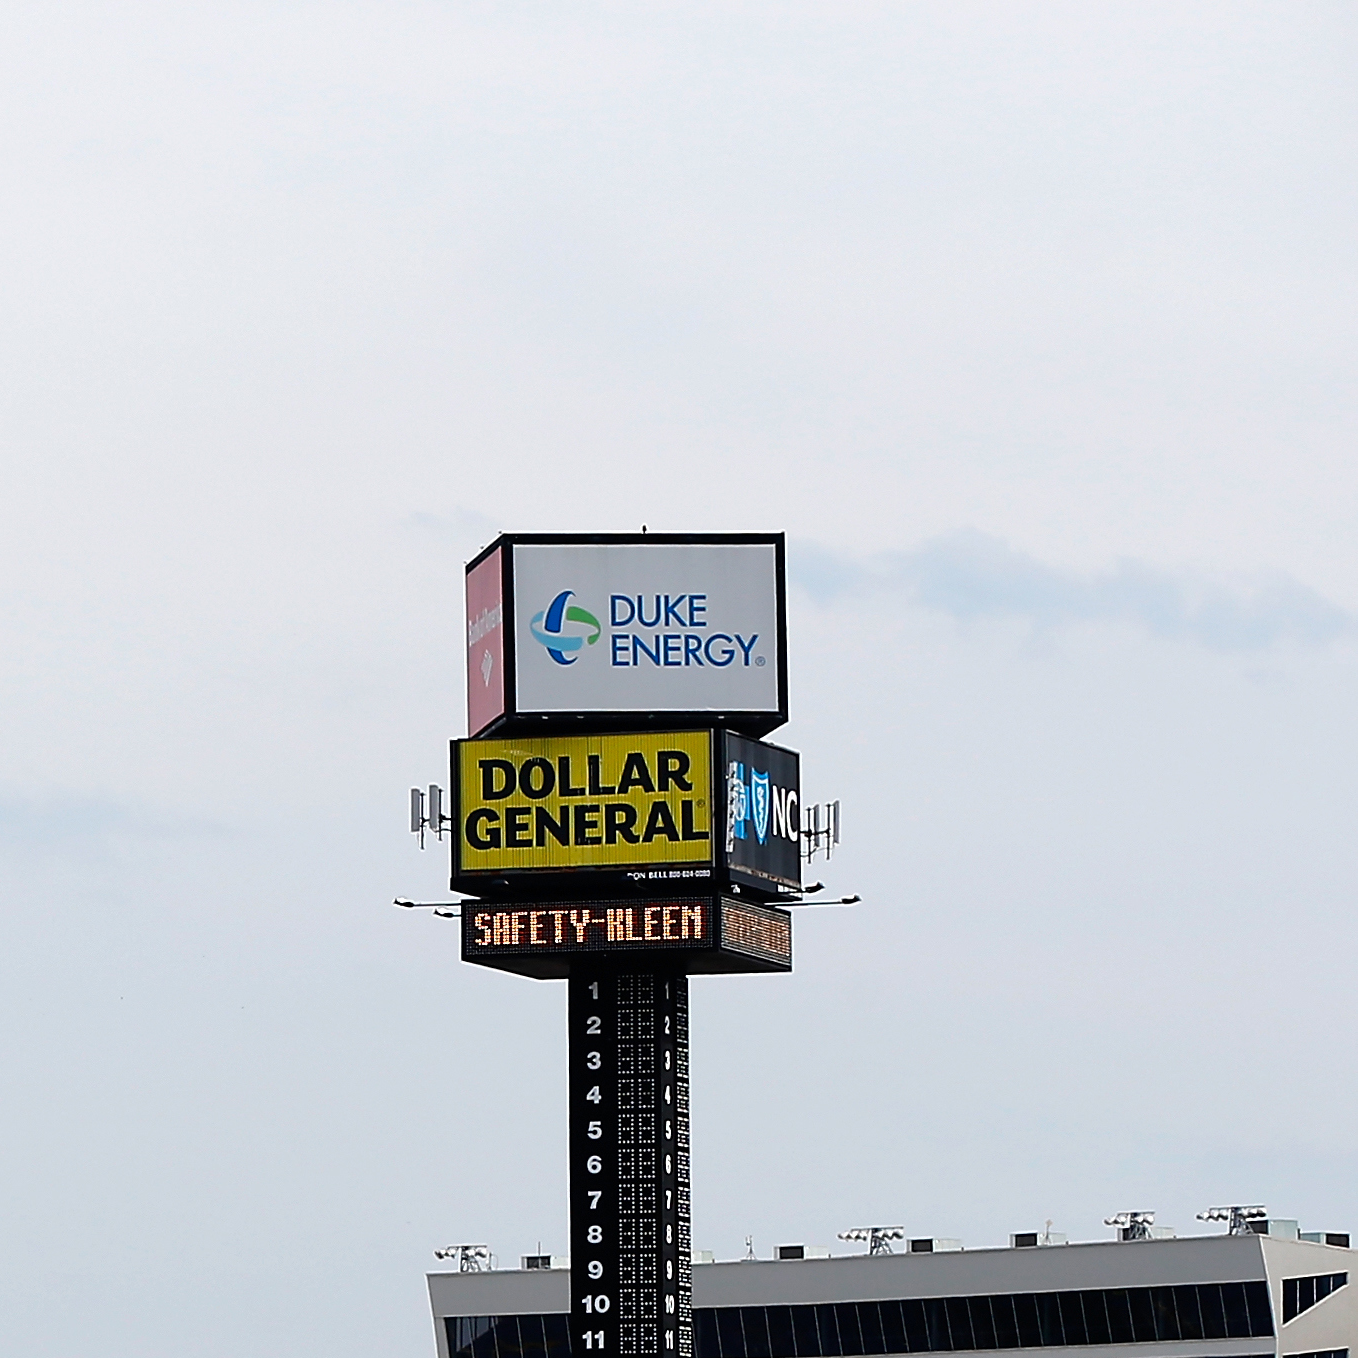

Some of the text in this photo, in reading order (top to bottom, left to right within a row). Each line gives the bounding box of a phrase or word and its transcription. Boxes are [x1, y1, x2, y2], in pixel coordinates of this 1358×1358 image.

[610, 594, 707, 627] DUKE
[611, 633, 759, 667] ENERGY
[478, 750, 693, 801] DOLLAR
[772, 785, 799, 842] NC
[465, 799, 710, 850] GENERAL
[648, 870, 667, 879] BELL
[474, 906, 702, 946] SAFETY-KLEEN
[588, 983, 599, 1000] 1
[665, 982, 670, 1001] 1
[586, 1017, 602, 1034] 2
[664, 1016, 672, 1035] 2
[586, 1052, 602, 1069] 3
[664, 1051, 672, 1070] 3
[586, 1086, 602, 1103] 4
[664, 1085, 672, 1104] 4
[586, 1121, 602, 1139] 5
[664, 1120, 672, 1140] 5
[586, 1156, 602, 1173] 6
[664, 1155, 672, 1174] 6
[586, 1191, 602, 1209] 7
[664, 1190, 672, 1210] 7
[586, 1226, 602, 1243] 8
[664, 1225, 672, 1244] 8
[586, 1261, 602, 1279] 9
[664, 1260, 672, 1280] 9
[582, 1295, 611, 1313] 10
[665, 1294, 676, 1314] 10
[582, 1331, 605, 1349] 11
[665, 1330, 676, 1350] 11
